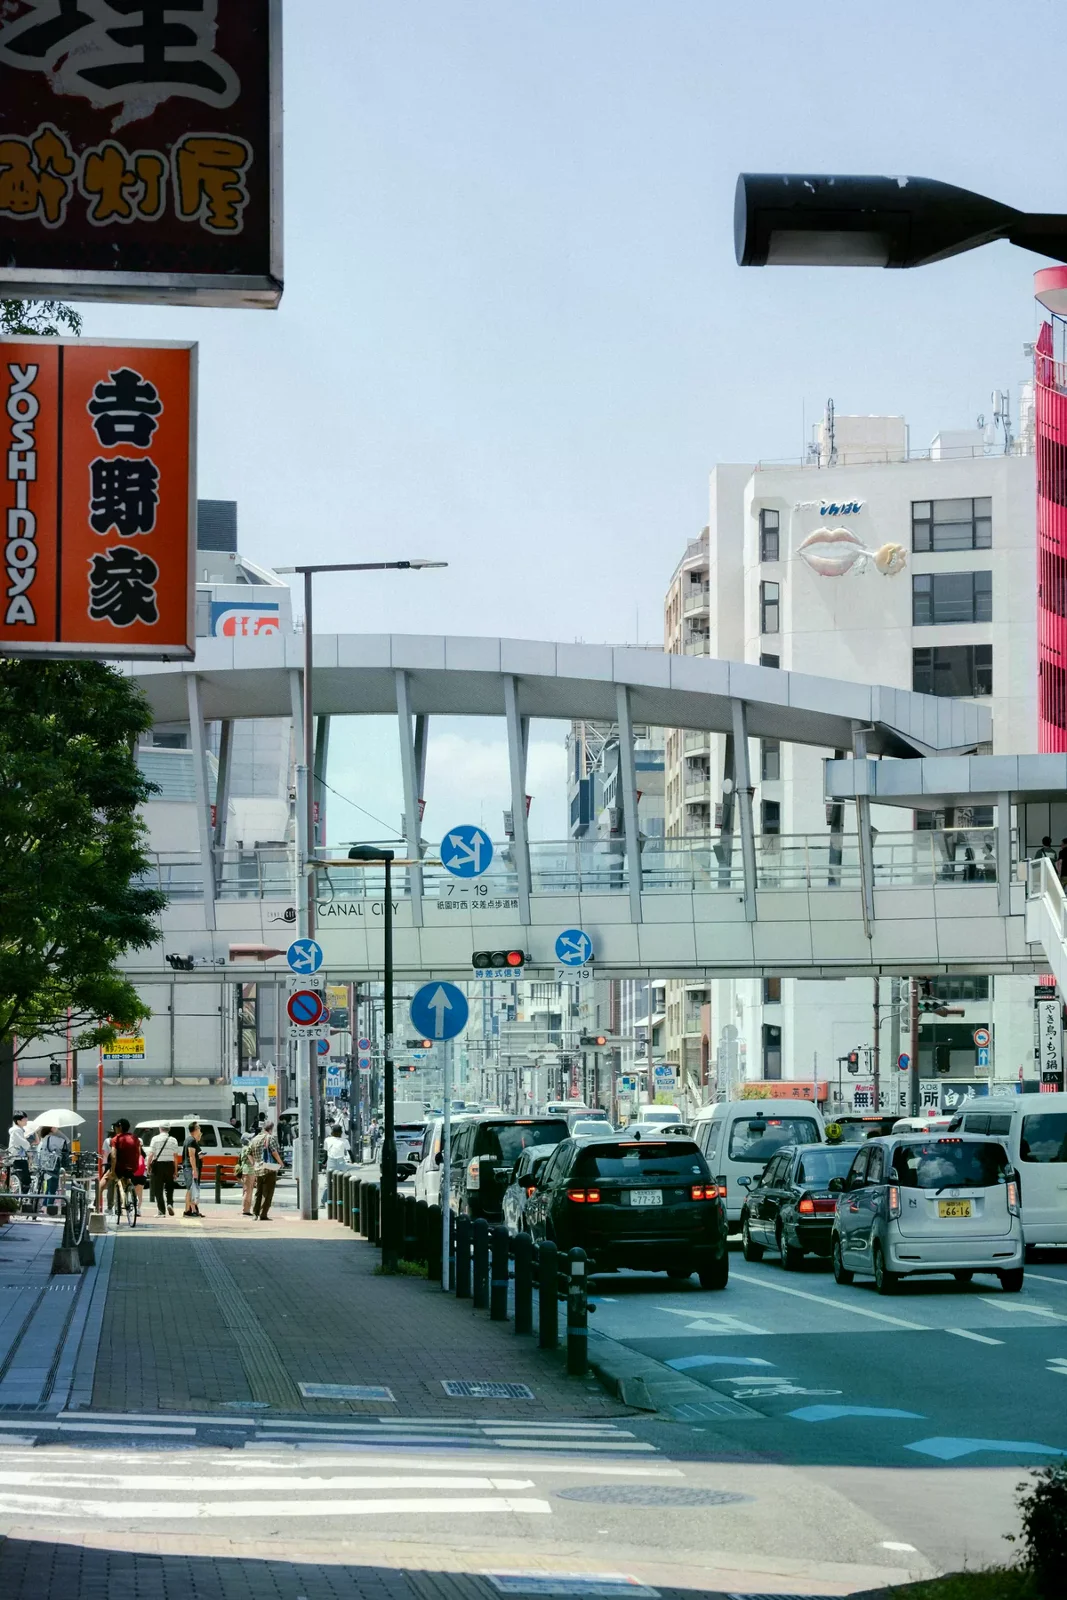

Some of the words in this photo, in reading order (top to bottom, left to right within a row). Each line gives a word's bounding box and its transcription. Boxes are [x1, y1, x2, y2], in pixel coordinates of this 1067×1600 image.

[5, 363, 40, 626] YOSHINOYA
[87, 366, 163, 627] 吉野家
[318, 903, 364, 917] CANAL
[371, 902, 399, 916] CIY
[290, 1028, 322, 1038] ここまで
[946, 1207, 970, 1216] 66-16
